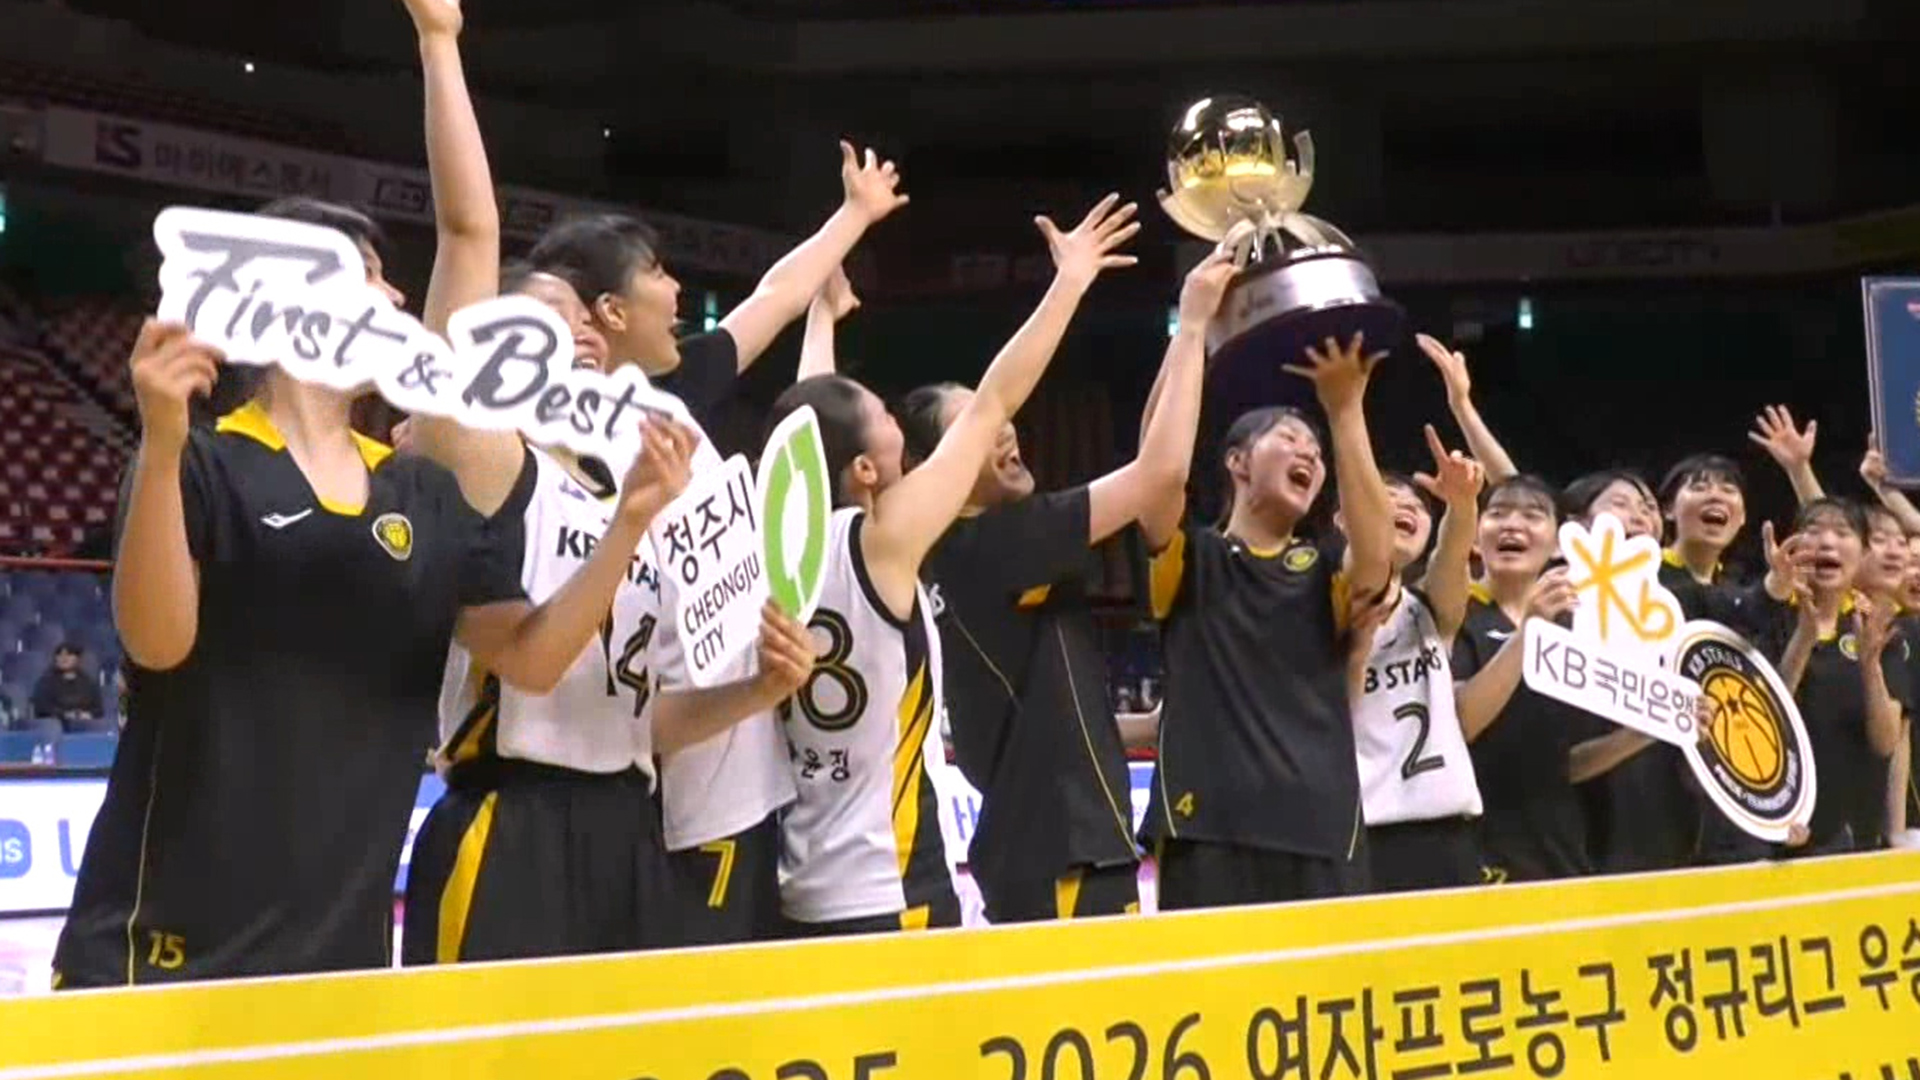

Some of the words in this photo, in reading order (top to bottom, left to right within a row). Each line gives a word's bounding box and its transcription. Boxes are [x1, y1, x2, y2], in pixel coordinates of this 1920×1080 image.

[179, 229, 408, 368] First
[396, 350, 453, 396] &
[461, 314, 674, 441] Best
[662, 471, 756, 586] 청주시
[684, 551, 761, 636] CHEONGJU
[692, 622, 726, 671] CITY
[779, 607, 869, 733] 8
[1393, 701, 1446, 781] 2
[1175, 791, 1195, 818] 4
[147, 929, 187, 970] 15
[1246, 961, 1627, 1080] 여자프로농구
[1647, 934, 1846, 1054] 정규리그
